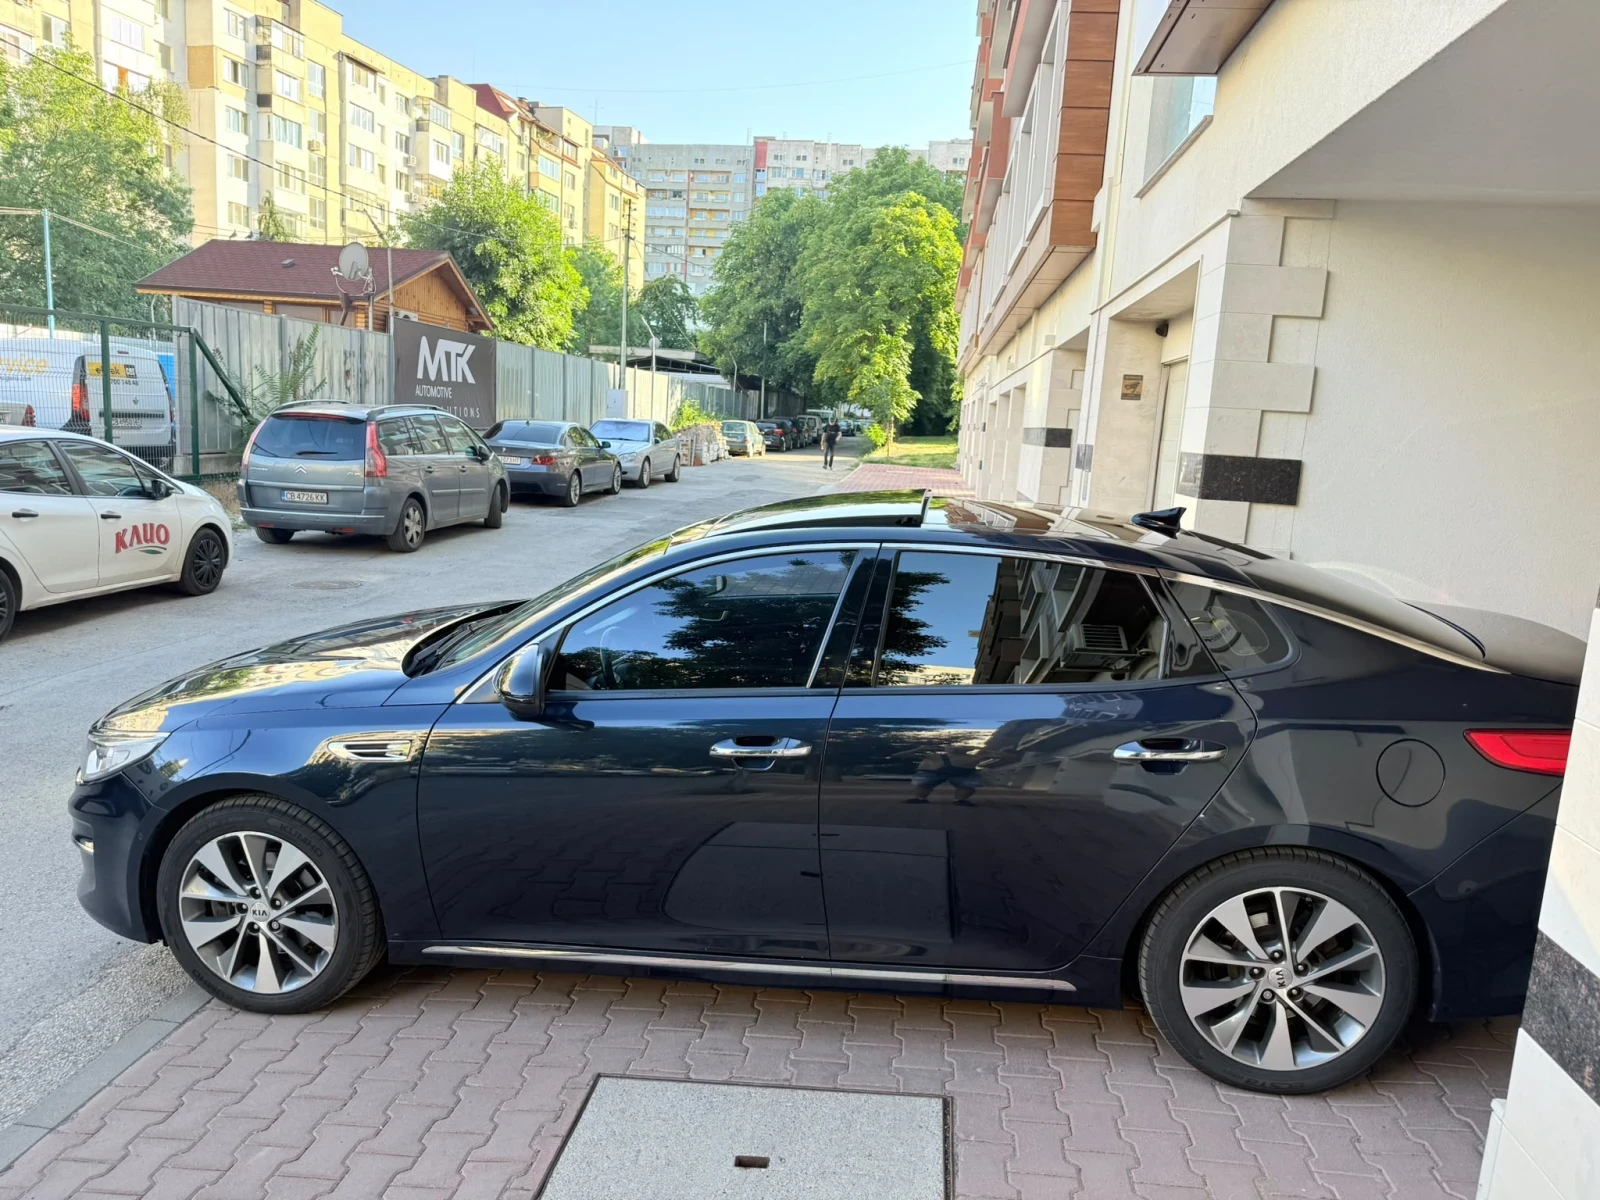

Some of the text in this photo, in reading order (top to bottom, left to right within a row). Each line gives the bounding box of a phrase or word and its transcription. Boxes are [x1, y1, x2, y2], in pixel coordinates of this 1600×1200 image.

[417, 335, 476, 384] MTK
[415, 384, 452, 399] AUTOMOTIVE
[286, 491, 324, 502] CB 4726 KK
[1275, 970, 1286, 987] KIA
